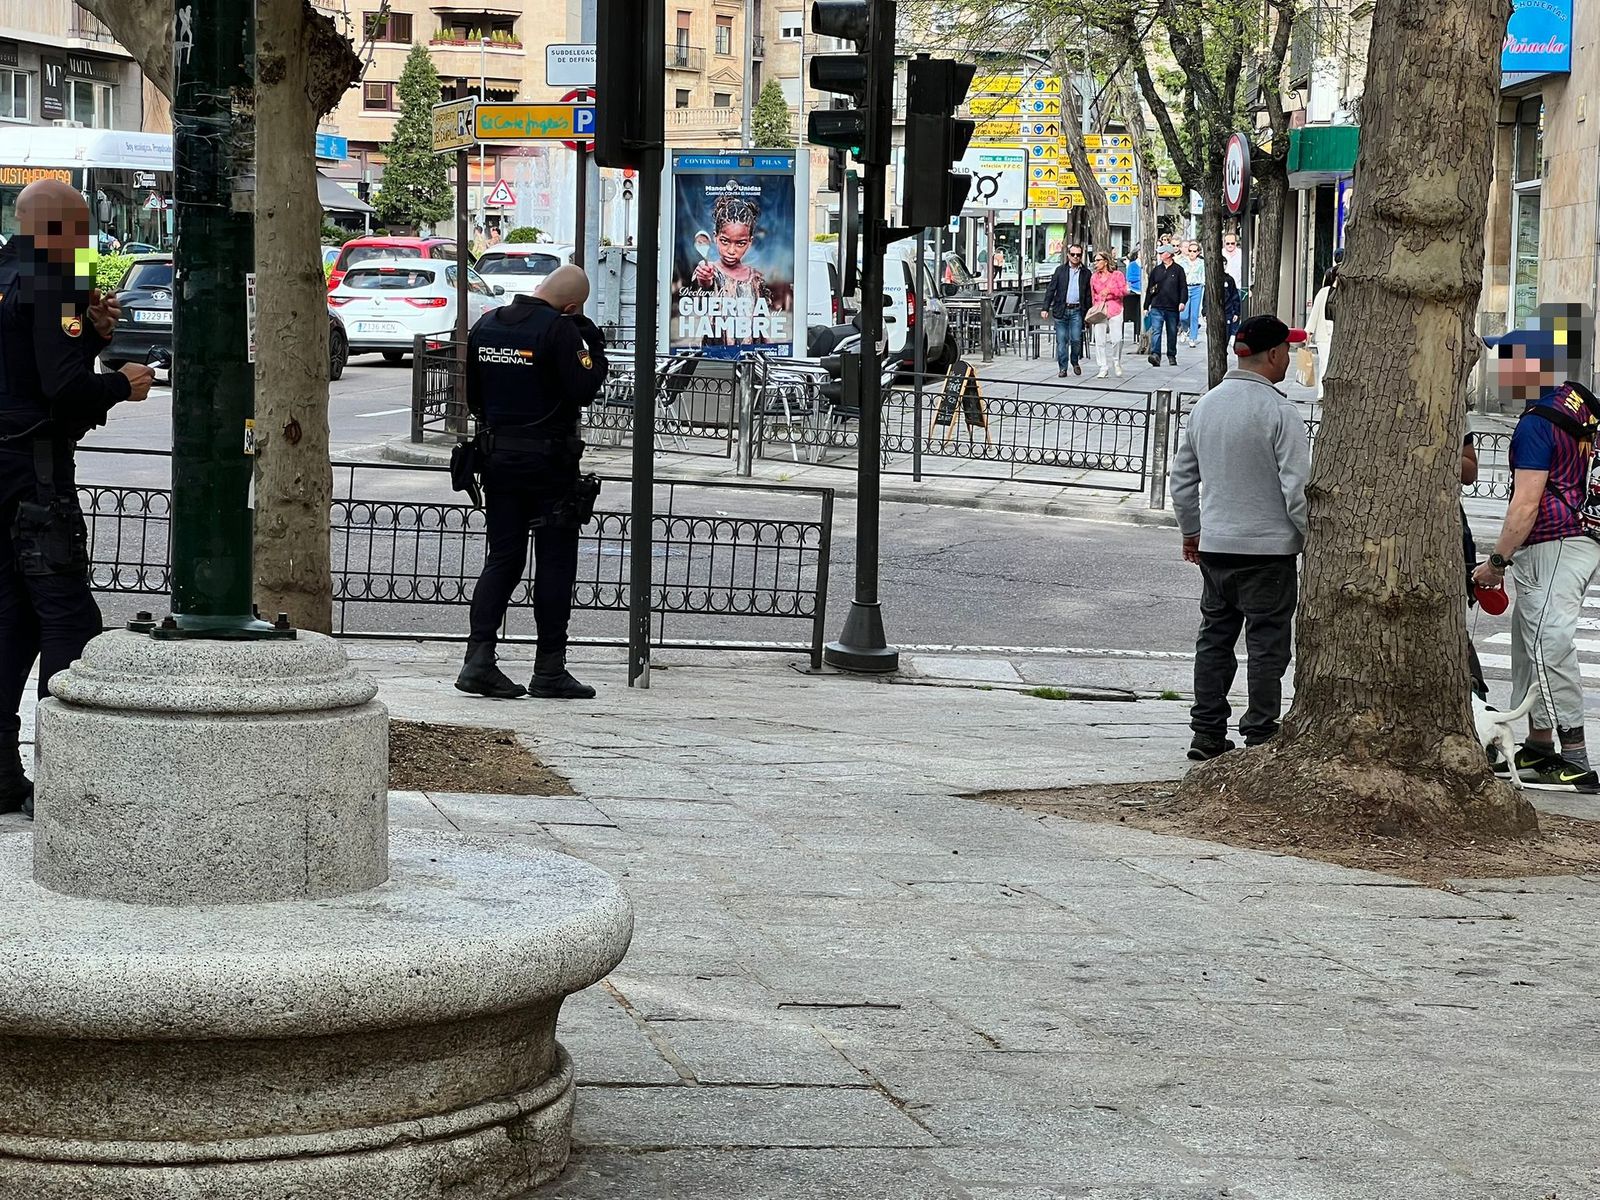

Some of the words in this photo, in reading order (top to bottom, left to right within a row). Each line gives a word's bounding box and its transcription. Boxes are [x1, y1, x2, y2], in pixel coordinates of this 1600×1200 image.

[577, 110, 593, 132] P
[679, 297, 770, 316] GUERRA
[141, 312, 161, 321] 3229
[679, 316, 787, 338] HAMBRE
[479, 347, 520, 356] POLICIA
[479, 355, 533, 365] NACIONAL
[1564, 390, 1585, 413] YAM
